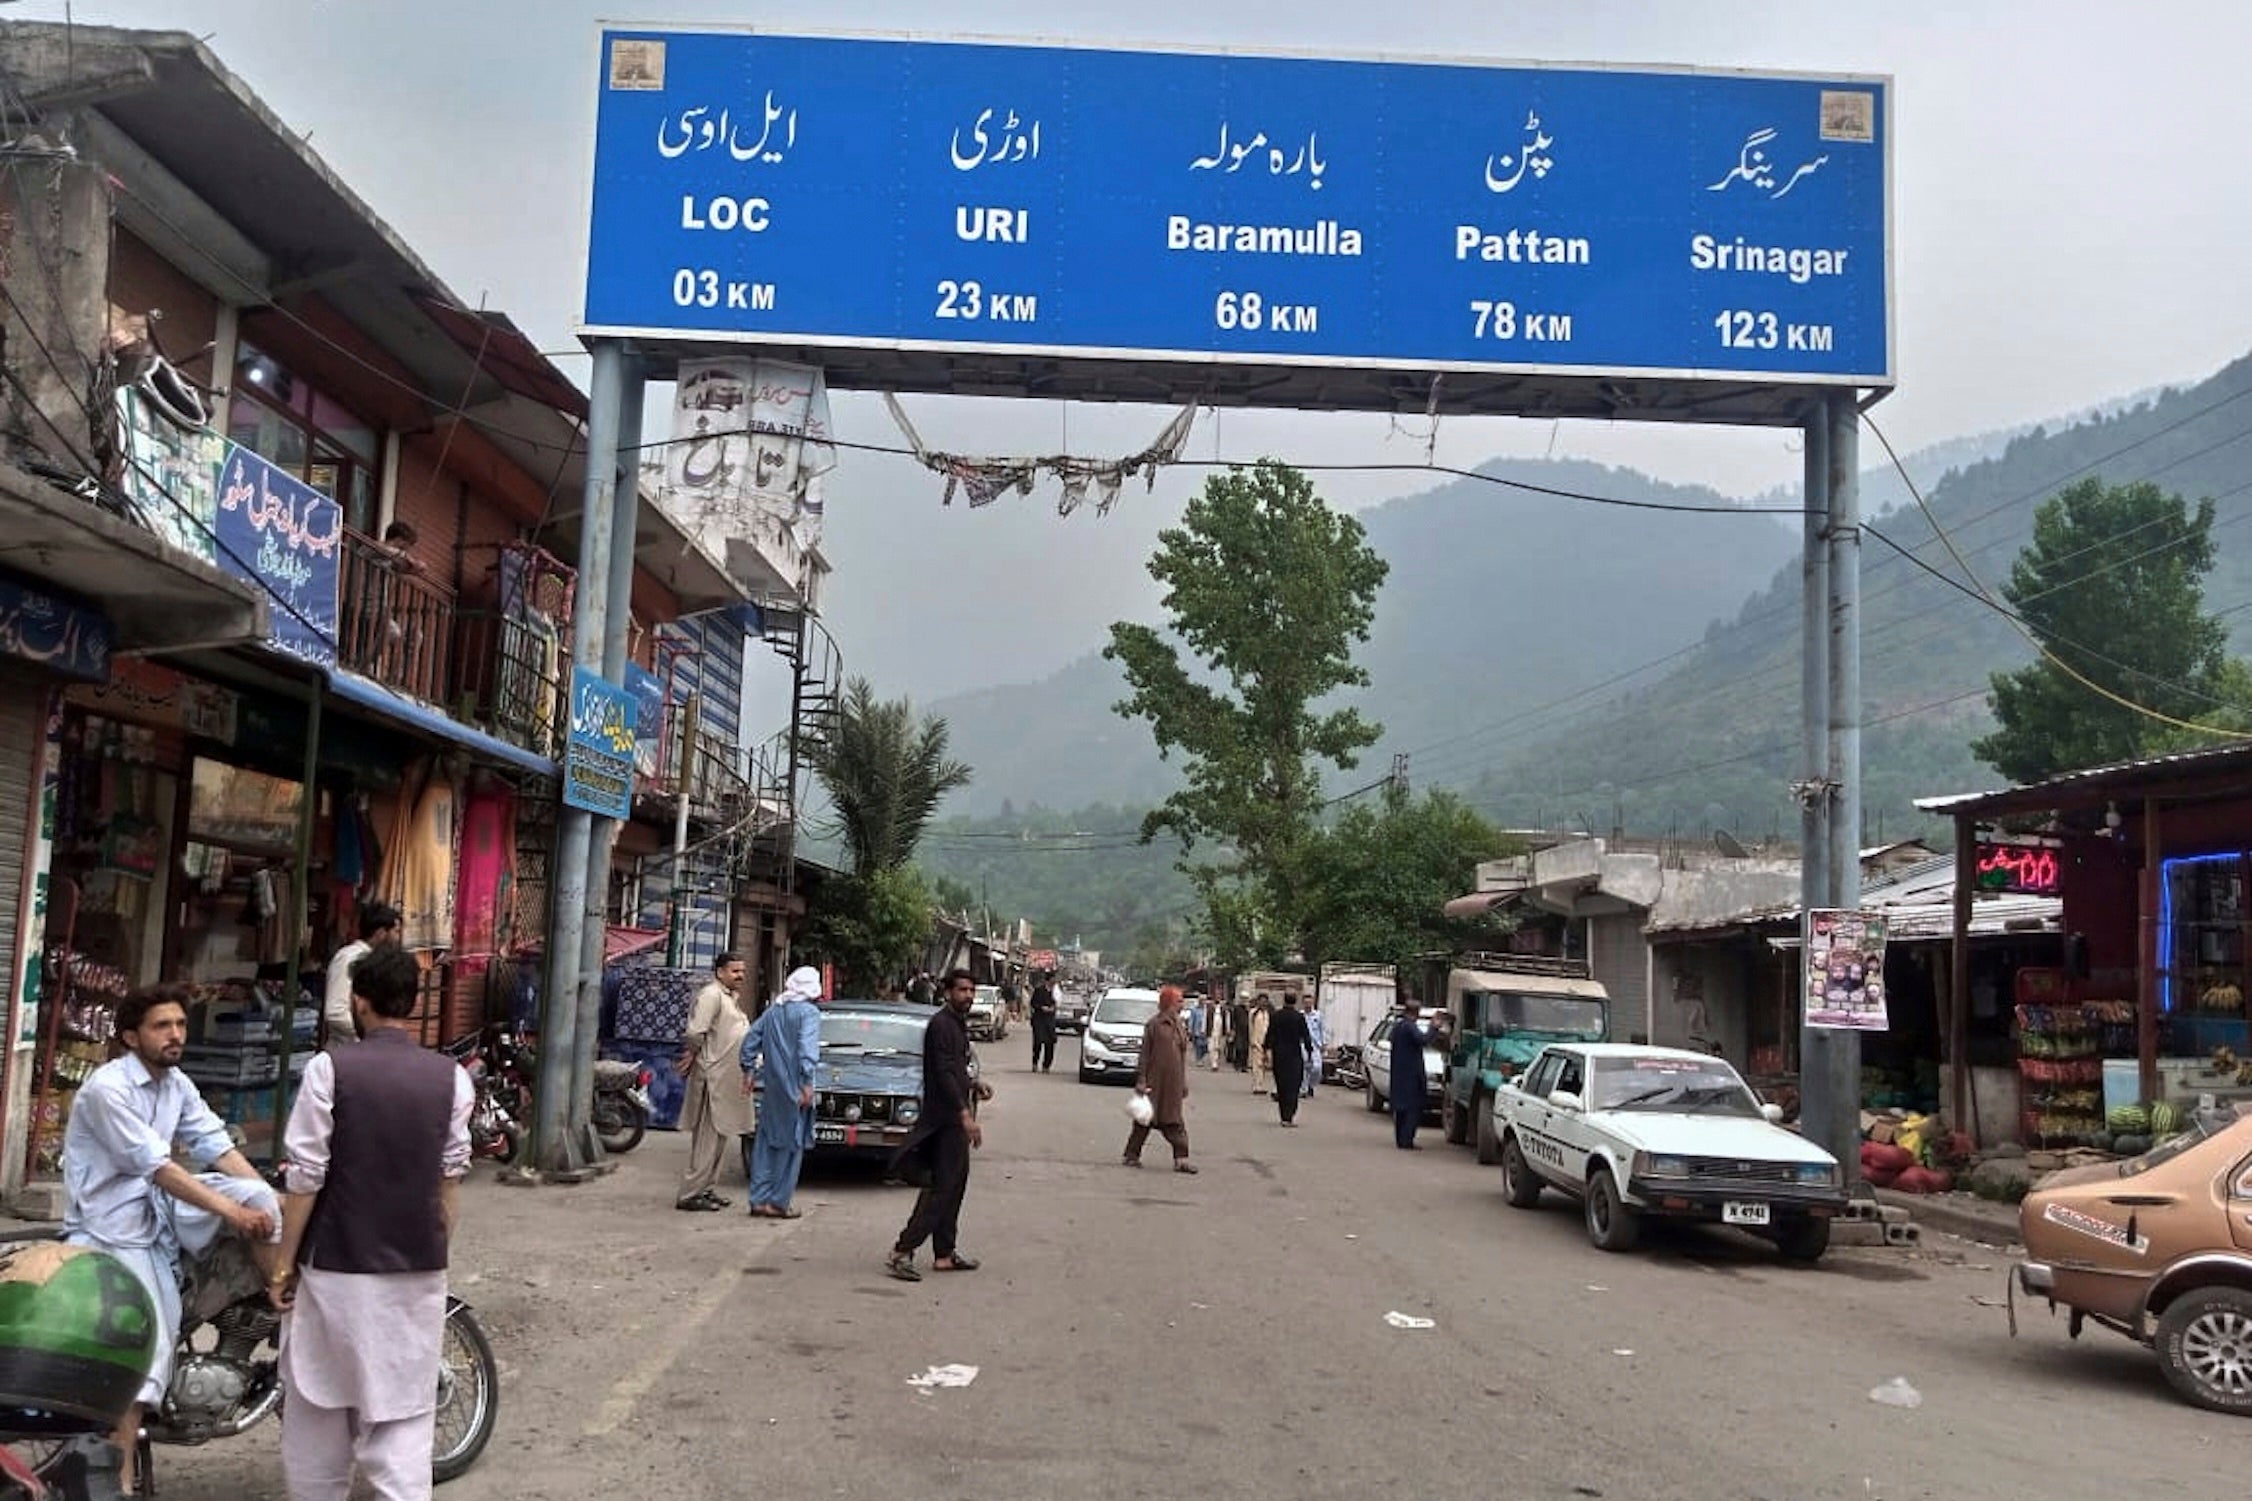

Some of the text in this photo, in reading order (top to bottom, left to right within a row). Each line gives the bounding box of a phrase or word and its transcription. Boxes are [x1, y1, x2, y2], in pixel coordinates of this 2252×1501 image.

[950, 108, 1041, 171] اوڑی
[1484, 110, 1554, 193] پٹن
[681, 195, 770, 232] LOC
[955, 206, 1028, 243] URI
[1167, 216, 1363, 256] Baramulla
[1455, 224, 1590, 265] Pattan
[1690, 234, 1848, 284] Srinagar
[672, 268, 776, 311] 03 KM
[934, 279, 1037, 322] 23 KM
[1215, 290, 1318, 333] 68 KM
[1470, 300, 1572, 342] 78 KM
[1714, 309, 1834, 352] 123 KM
